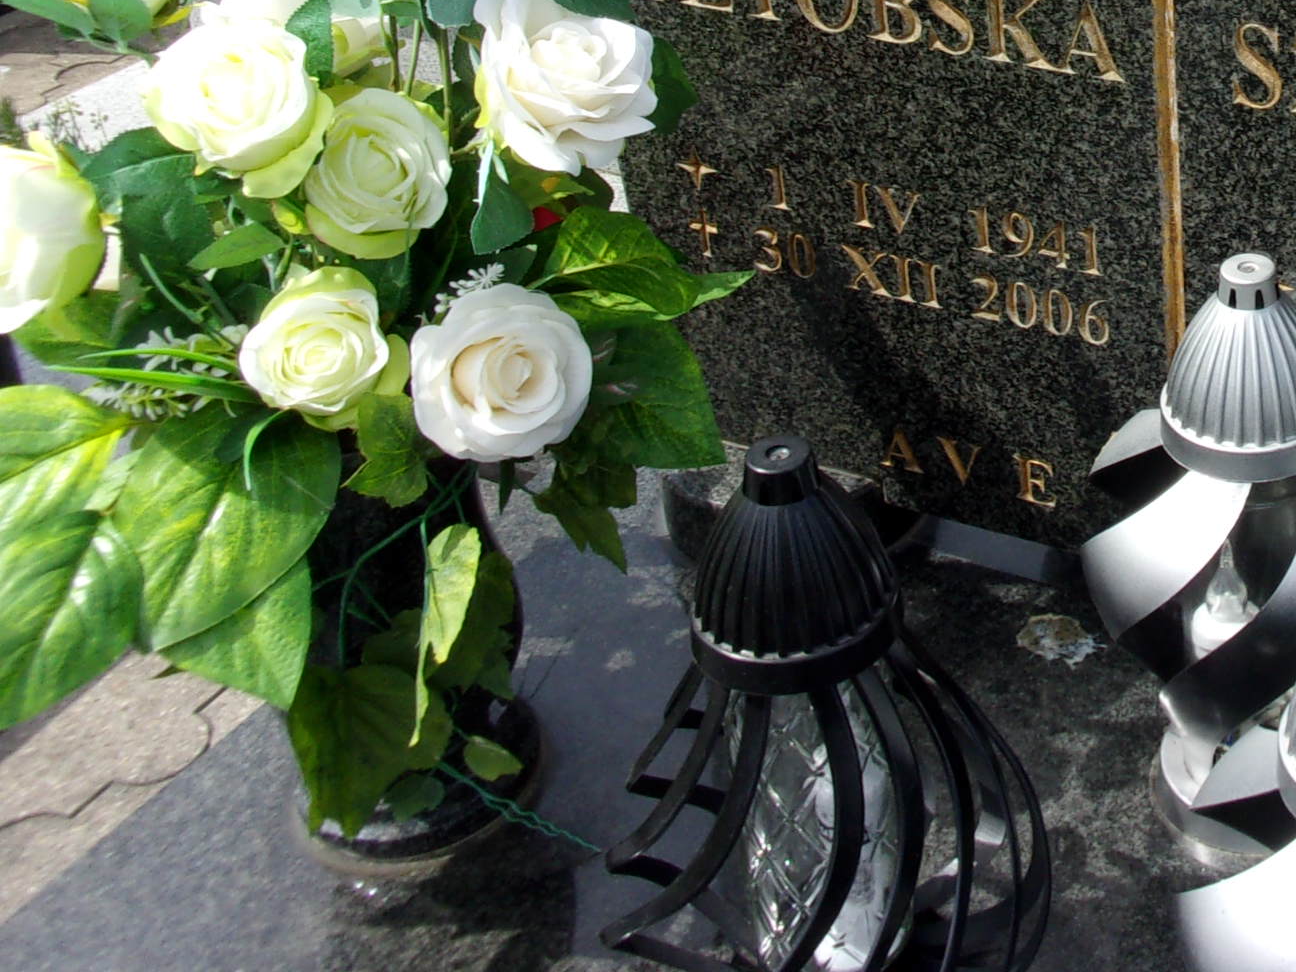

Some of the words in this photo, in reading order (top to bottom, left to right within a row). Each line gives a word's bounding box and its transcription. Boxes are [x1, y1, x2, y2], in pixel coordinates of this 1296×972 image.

[764, 163, 791, 211] 1
[845, 179, 922, 235] IV
[967, 204, 1103, 278] 1941
[753, 227, 818, 279] 30
[841, 243, 944, 310] XII
[970, 274, 1111, 347] 2006
